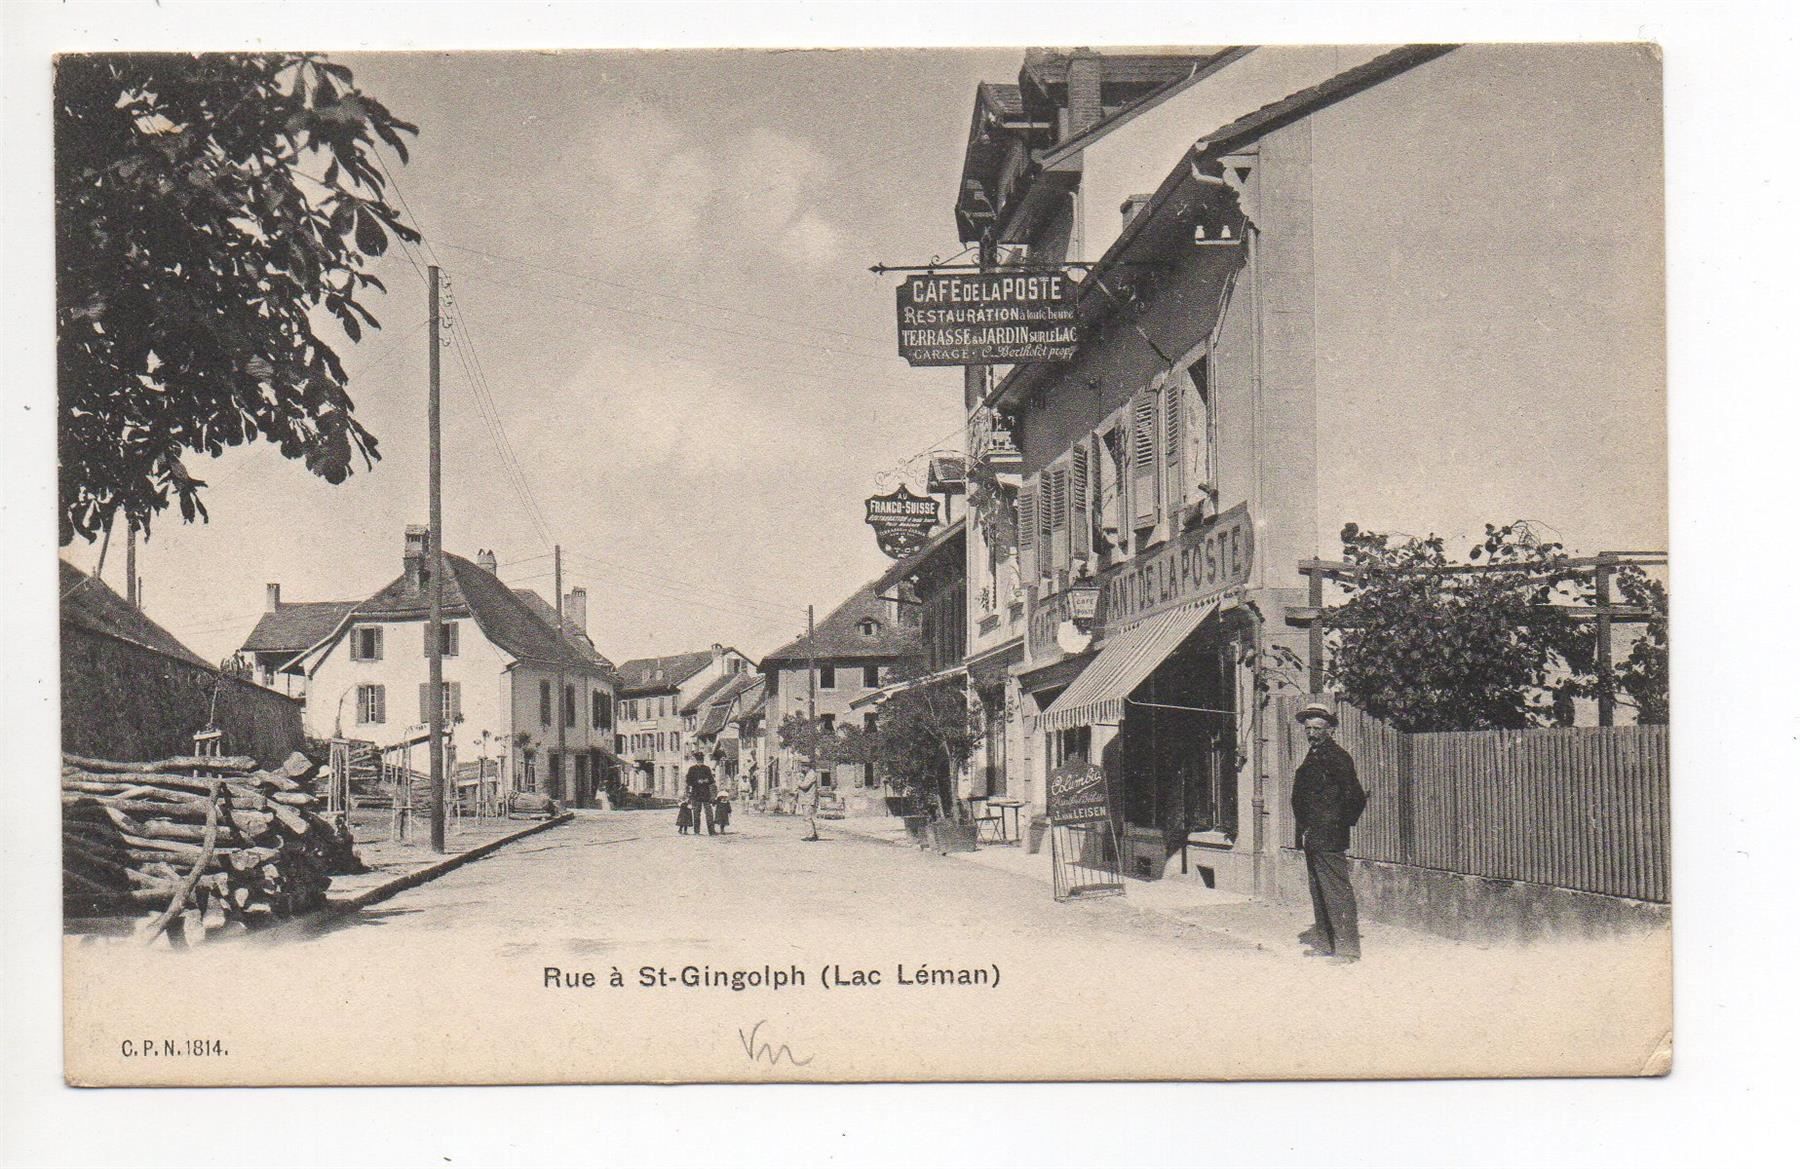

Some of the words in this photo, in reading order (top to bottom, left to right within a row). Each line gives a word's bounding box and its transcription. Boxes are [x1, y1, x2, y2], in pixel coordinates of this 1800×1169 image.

[963, 282, 979, 302] DE
[982, 282, 1000, 301] LA
[1003, 276, 1062, 301] POSTE
[904, 306, 1019, 325] RESTAURATION
[902, 327, 972, 347] TERRASSE
[979, 326, 1029, 345] JARDIN
[1029, 330, 1046, 343] SUR
[1055, 326, 1077, 342] LAC
[914, 349, 969, 360] GARAGE
[870, 500, 935, 515] FRANCO-SUISSE
[1158, 554, 1178, 601] LA
[1181, 525, 1240, 597] POSTE
[1073, 806, 1106, 820] LEISEN
